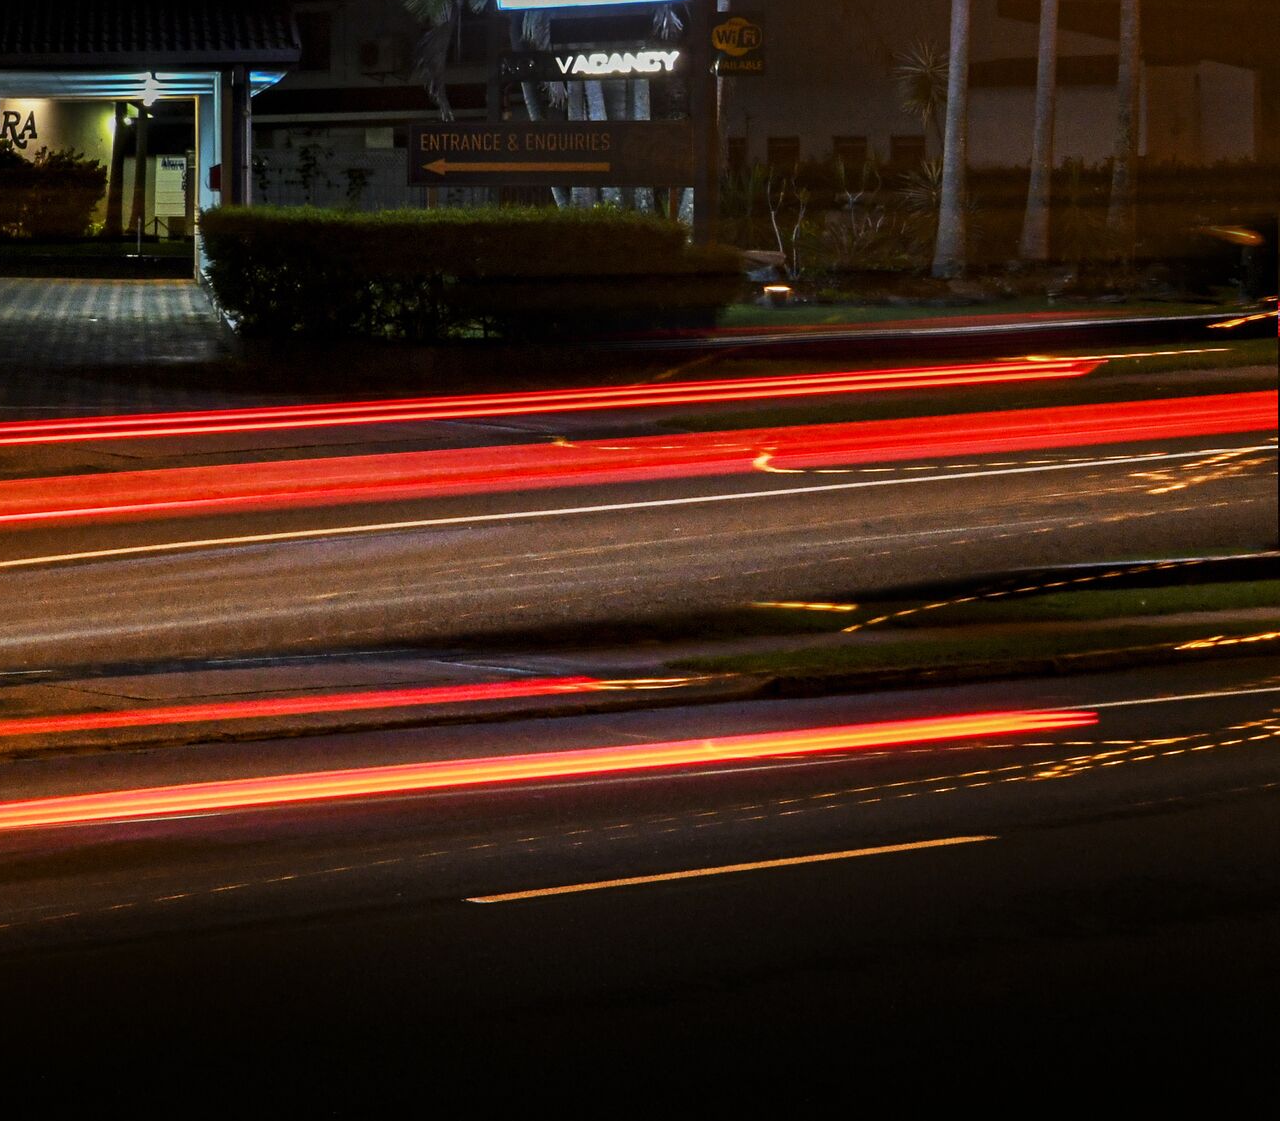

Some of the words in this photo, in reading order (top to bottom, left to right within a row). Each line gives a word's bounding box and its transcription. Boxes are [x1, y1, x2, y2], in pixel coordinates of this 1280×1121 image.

[554, 50, 680, 75] VACANCY
[420, 133, 501, 152] ENTRANCE
[507, 134, 520, 151] &
[525, 132, 611, 152] ENQUIRIES
